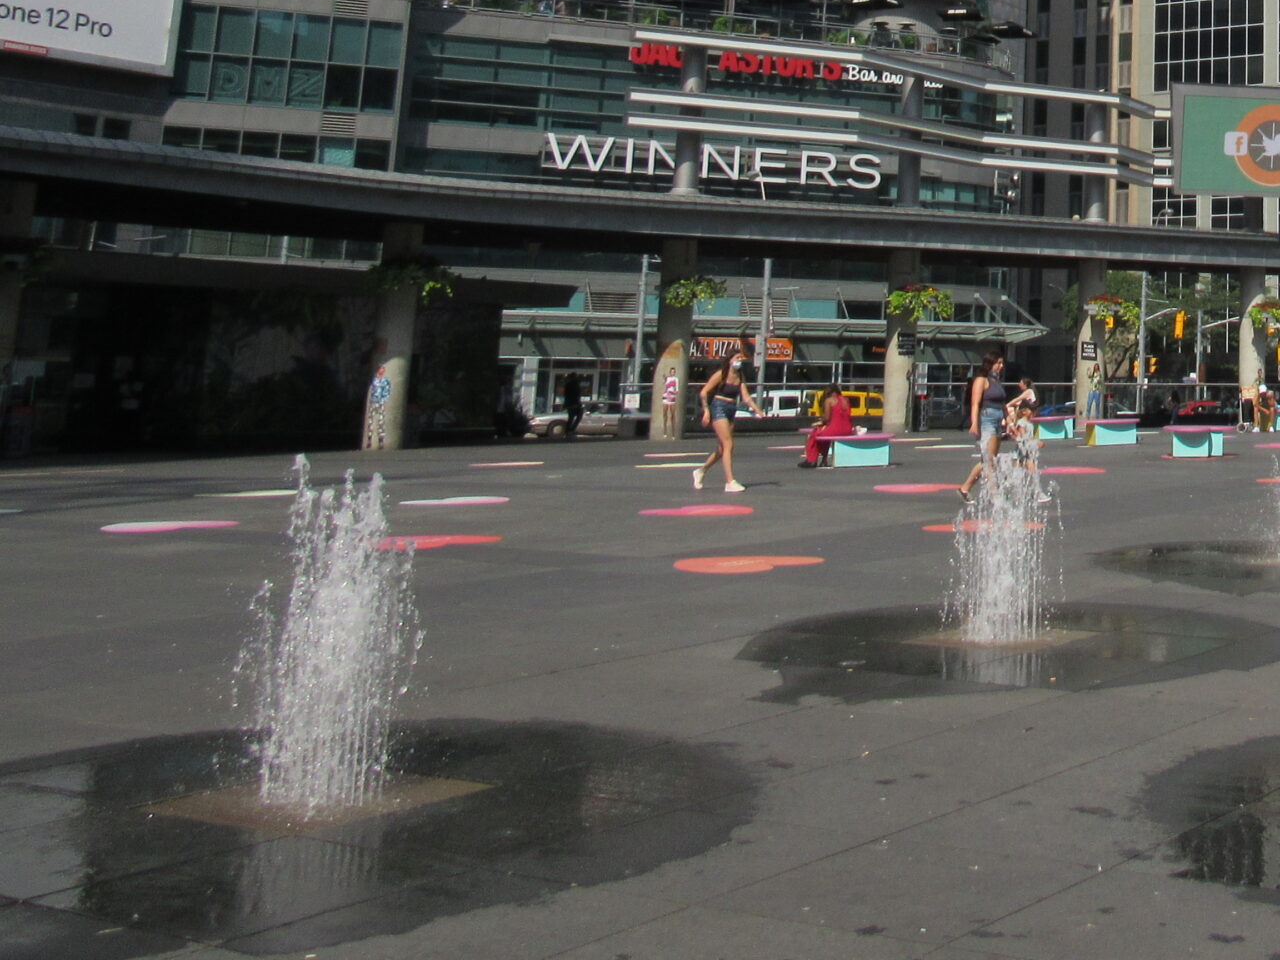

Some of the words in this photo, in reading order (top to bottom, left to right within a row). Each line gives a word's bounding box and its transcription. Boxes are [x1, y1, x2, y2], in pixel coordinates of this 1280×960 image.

[0, 3, 41, 24] one
[45, 7, 70, 30] 12
[75, 12, 113, 38] Pro
[846, 63, 878, 82] Bar
[547, 131, 882, 190] WINNERS
